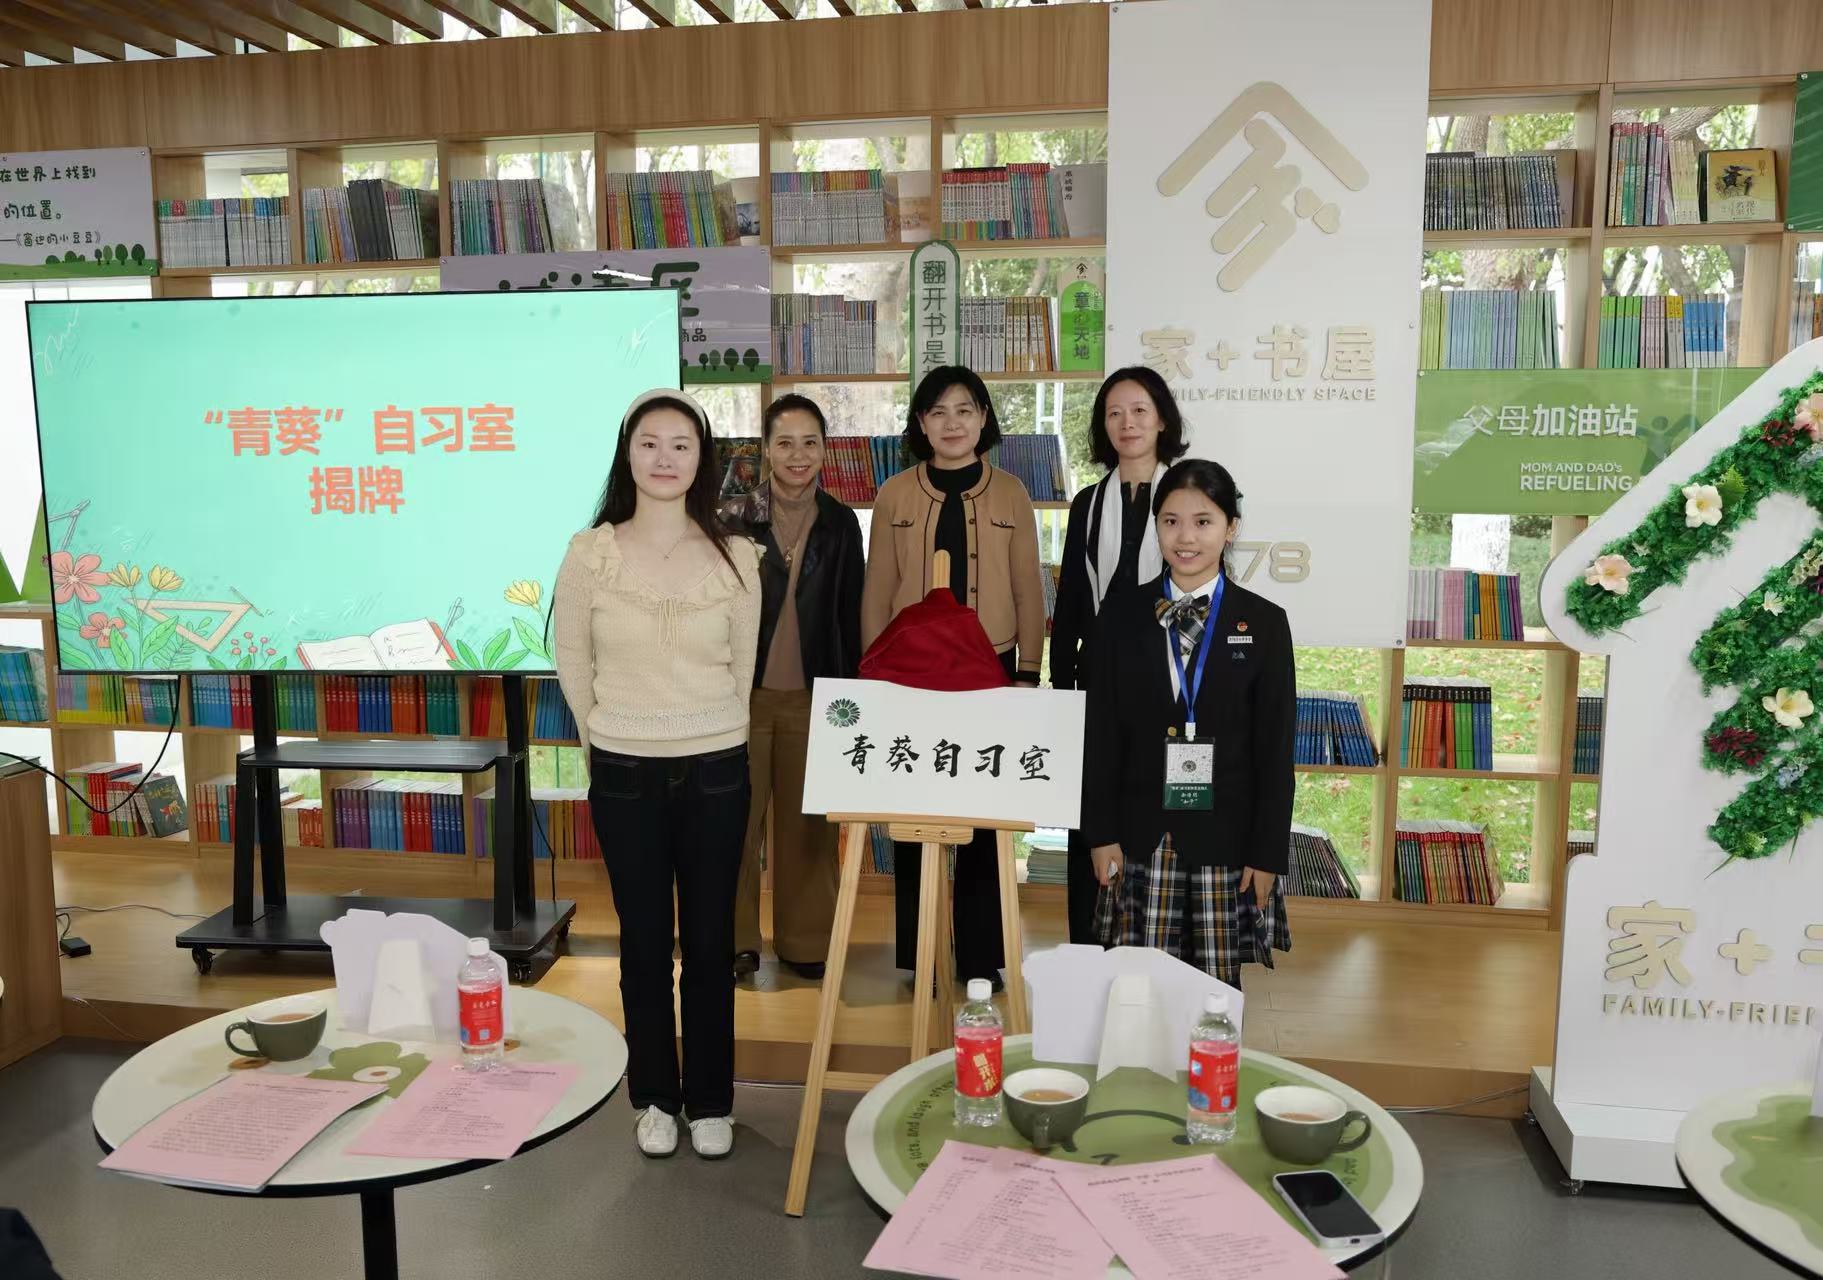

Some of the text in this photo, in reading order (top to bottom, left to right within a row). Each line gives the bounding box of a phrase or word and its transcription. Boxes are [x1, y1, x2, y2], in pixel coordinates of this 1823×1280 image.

[0, 165, 96, 182] 在世界上找到
[922, 260, 947, 377] 翻开书是
[1313, 387, 1376, 401] SPACE
[373, 403, 516, 455] 自习室
[1463, 403, 1638, 437] 父母加油站
[1520, 462, 1551, 473] MOM
[1555, 462, 1583, 473] AND
[1520, 475, 1633, 491] REFUELING
[308, 465, 405, 515] 揭牌
[1226, 541, 1311, 583] 78
[842, 734, 1051, 782] 青葵自习室
[1604, 900, 1823, 989] 家+
